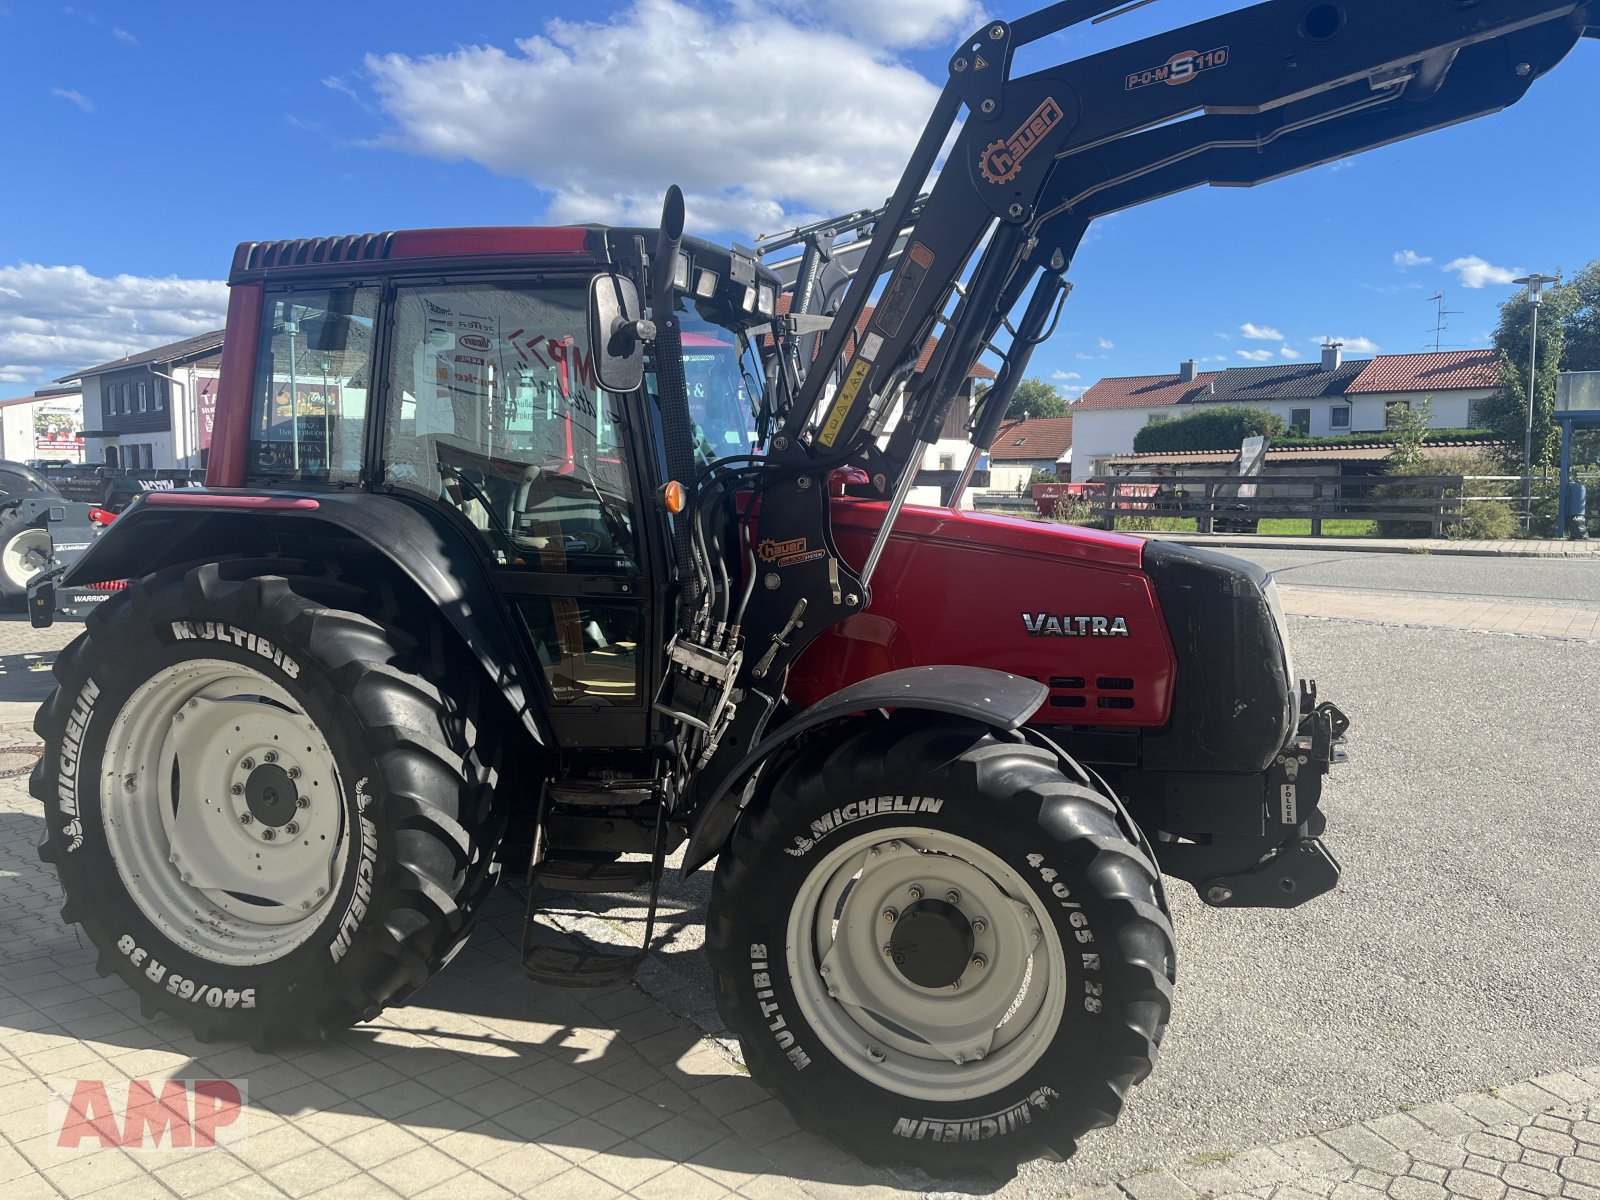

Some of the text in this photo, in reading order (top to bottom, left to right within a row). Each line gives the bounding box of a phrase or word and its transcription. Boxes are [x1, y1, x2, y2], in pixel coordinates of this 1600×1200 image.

[1196, 50, 1225, 69] 110
[991, 105, 1053, 174] hauer
[765, 541, 805, 556] hauer
[171, 621, 300, 680] MULTIBIB
[1022, 613, 1129, 637] VALTRA
[58, 677, 101, 816] MICHELIN
[811, 795, 944, 838] MICHELIN
[1285, 785, 1293, 823] FOLGER
[329, 816, 378, 964] MICHELIN
[1026, 853, 1102, 1014] 440/65 R 28
[117, 934, 256, 1008] 540/65 R 38
[750, 943, 812, 1071] MULTIBIB
[892, 1100, 1034, 1143] MICHELIN
